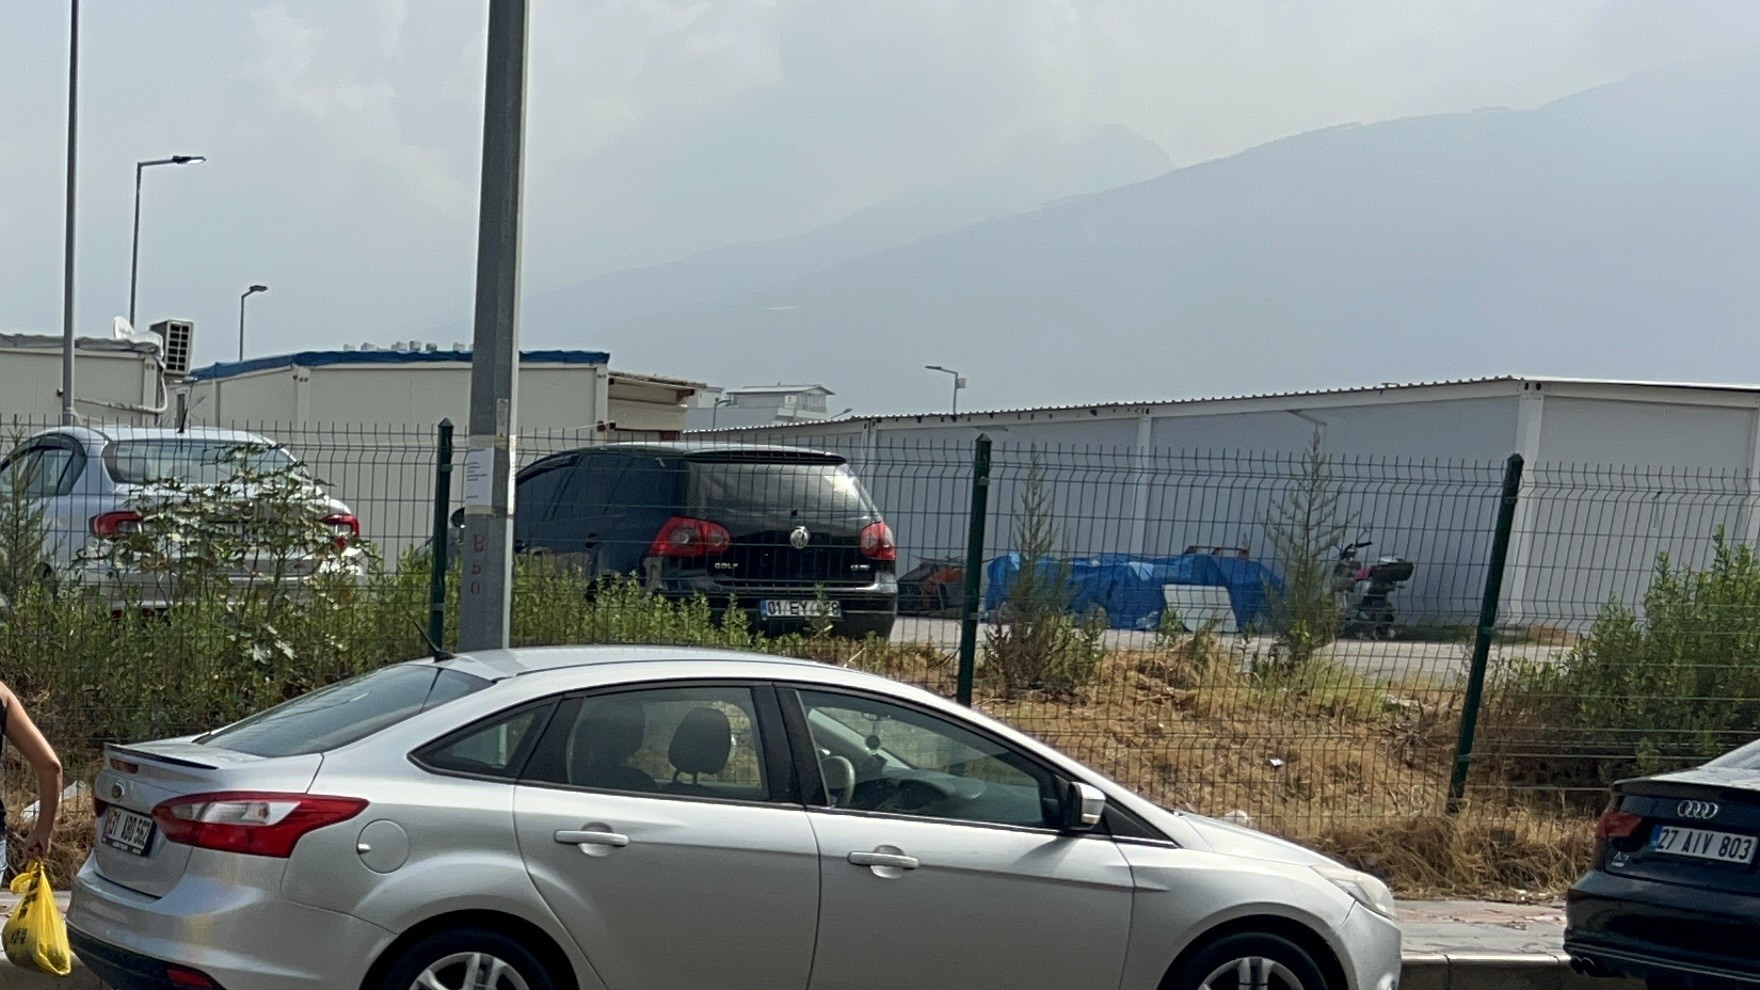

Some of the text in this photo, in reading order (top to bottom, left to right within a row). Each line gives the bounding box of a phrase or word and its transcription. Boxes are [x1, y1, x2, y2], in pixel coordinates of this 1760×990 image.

[767, 600, 782, 615] 01
[1658, 829, 1679, 850] 27
[1718, 836, 1752, 860] 803
